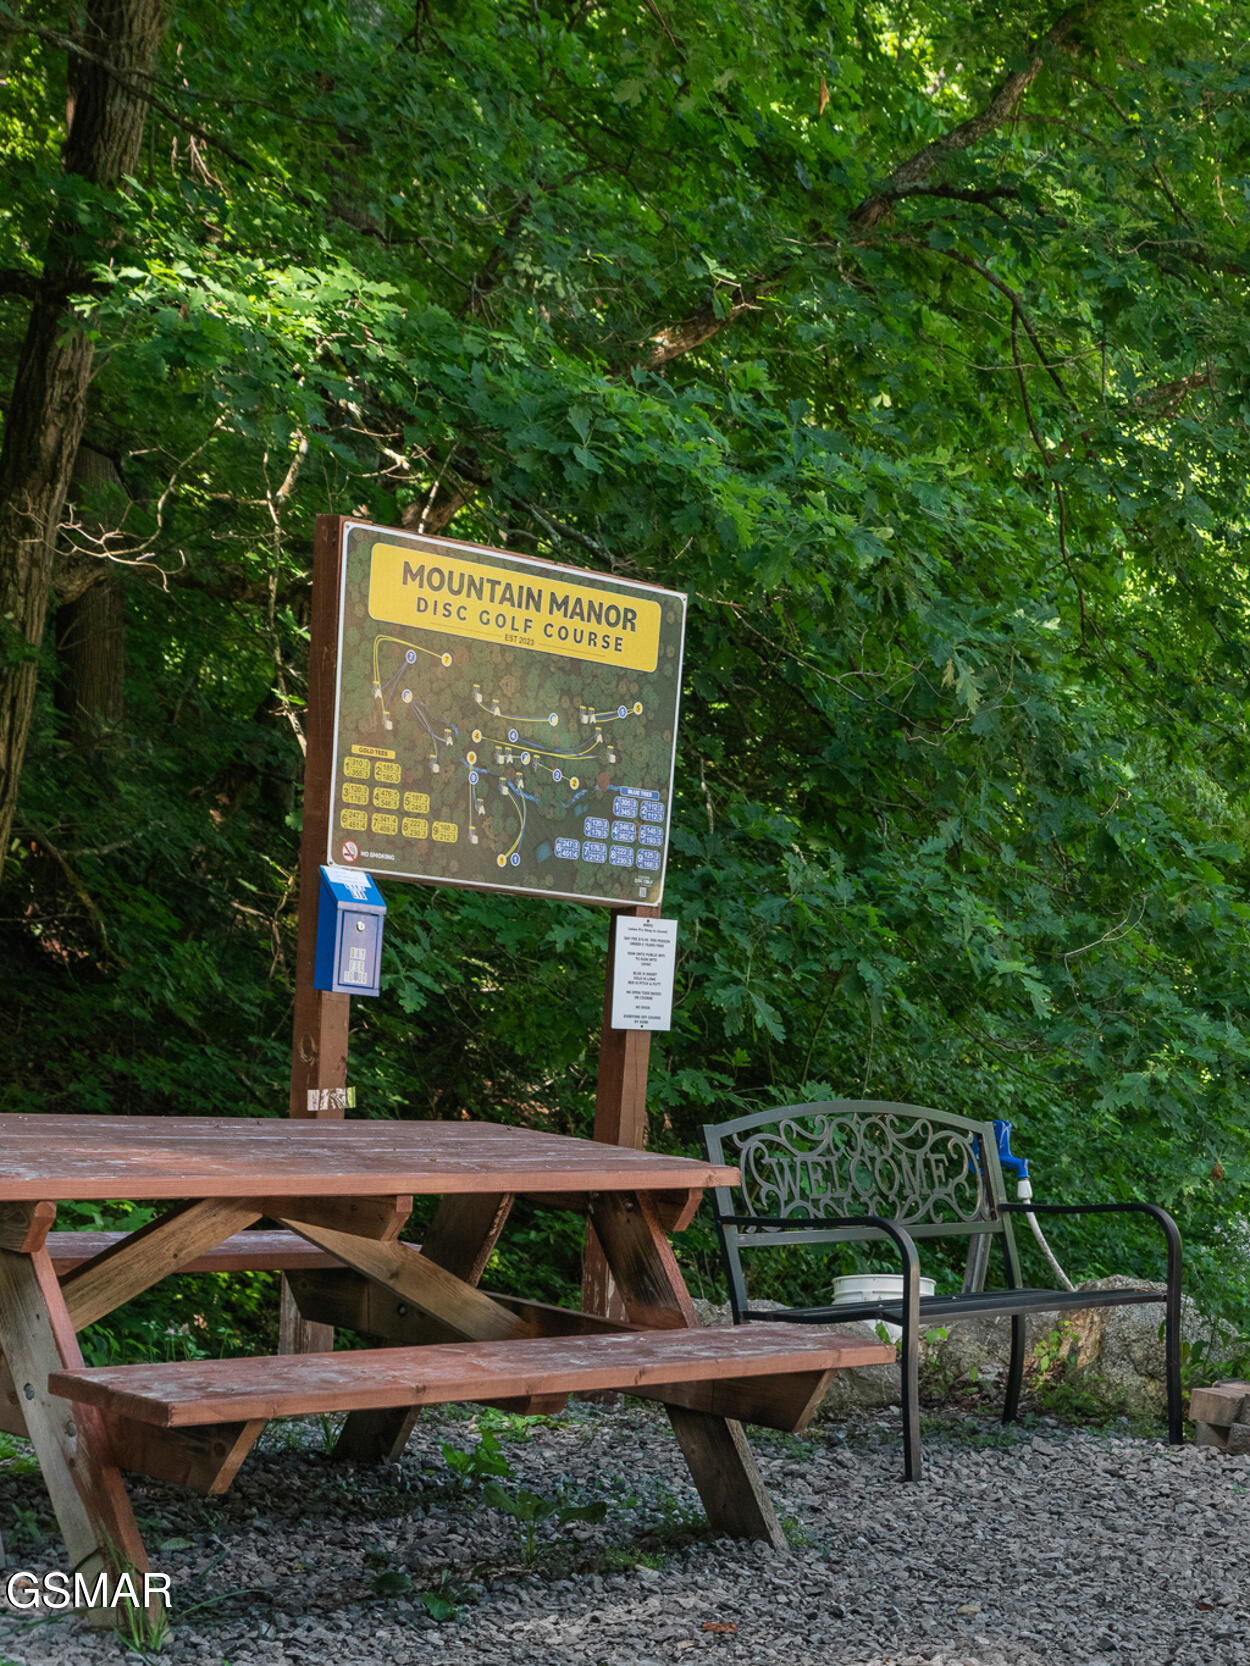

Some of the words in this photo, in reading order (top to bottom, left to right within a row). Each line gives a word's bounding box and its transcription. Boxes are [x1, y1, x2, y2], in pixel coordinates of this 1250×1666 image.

[402, 560, 542, 613] MOUNTAIN
[549, 591, 637, 632] MANOR
[416, 597, 468, 621] DISC
[479, 610, 533, 634] GOLF
[543, 623, 623, 652] COURSE
[504, 633, 518, 643] EST
[518, 636, 535, 647] 2023
[762, 1152, 952, 1200] WELCOME
